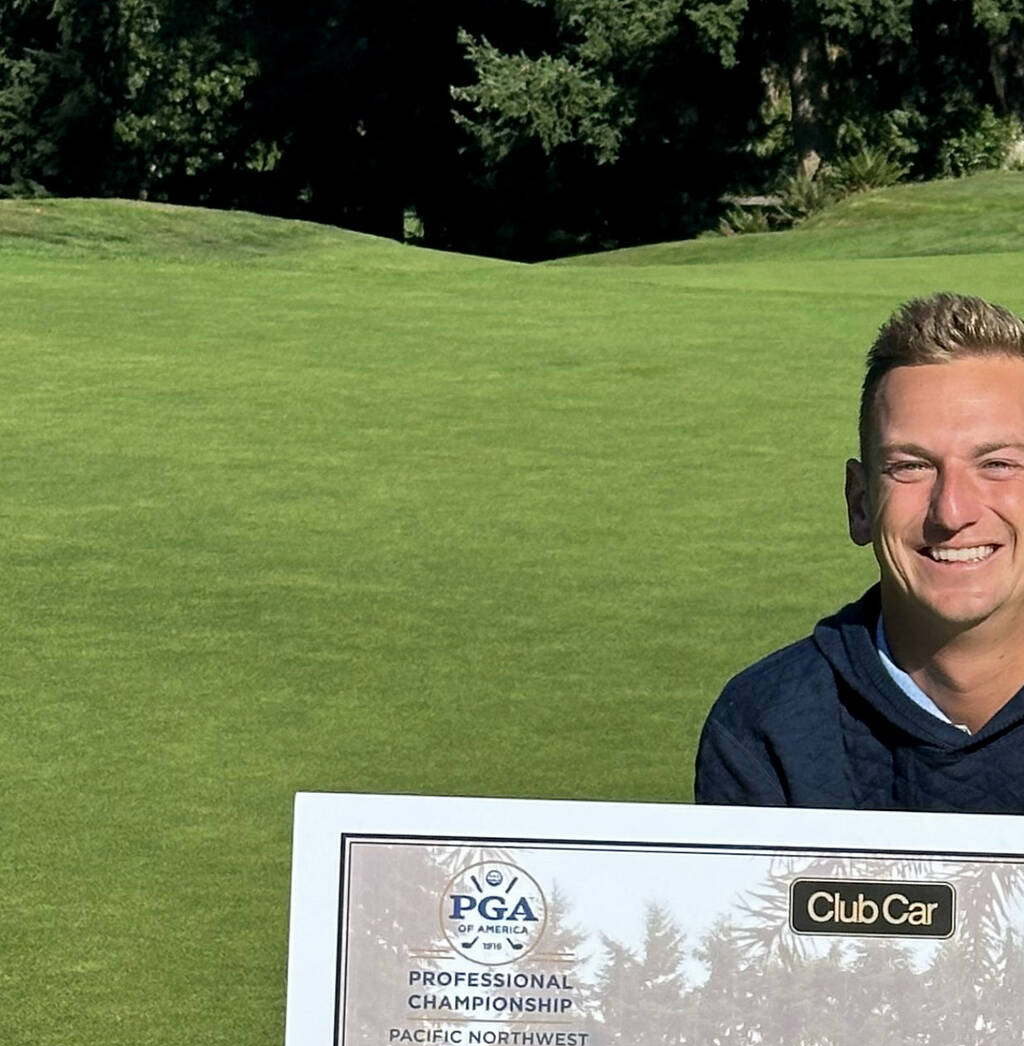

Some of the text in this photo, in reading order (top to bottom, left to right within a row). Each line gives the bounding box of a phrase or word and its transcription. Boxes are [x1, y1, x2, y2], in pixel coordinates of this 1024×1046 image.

[449, 895, 539, 921] PGA
[807, 891, 938, 928] Club Car
[458, 924, 529, 936] OF AMERICA
[482, 943, 503, 951] 1916
[409, 971, 574, 990] PROFESSIONAL
[408, 994, 573, 1014] CHAMPIONSHIP
[389, 1028, 463, 1045] PACIFIC
